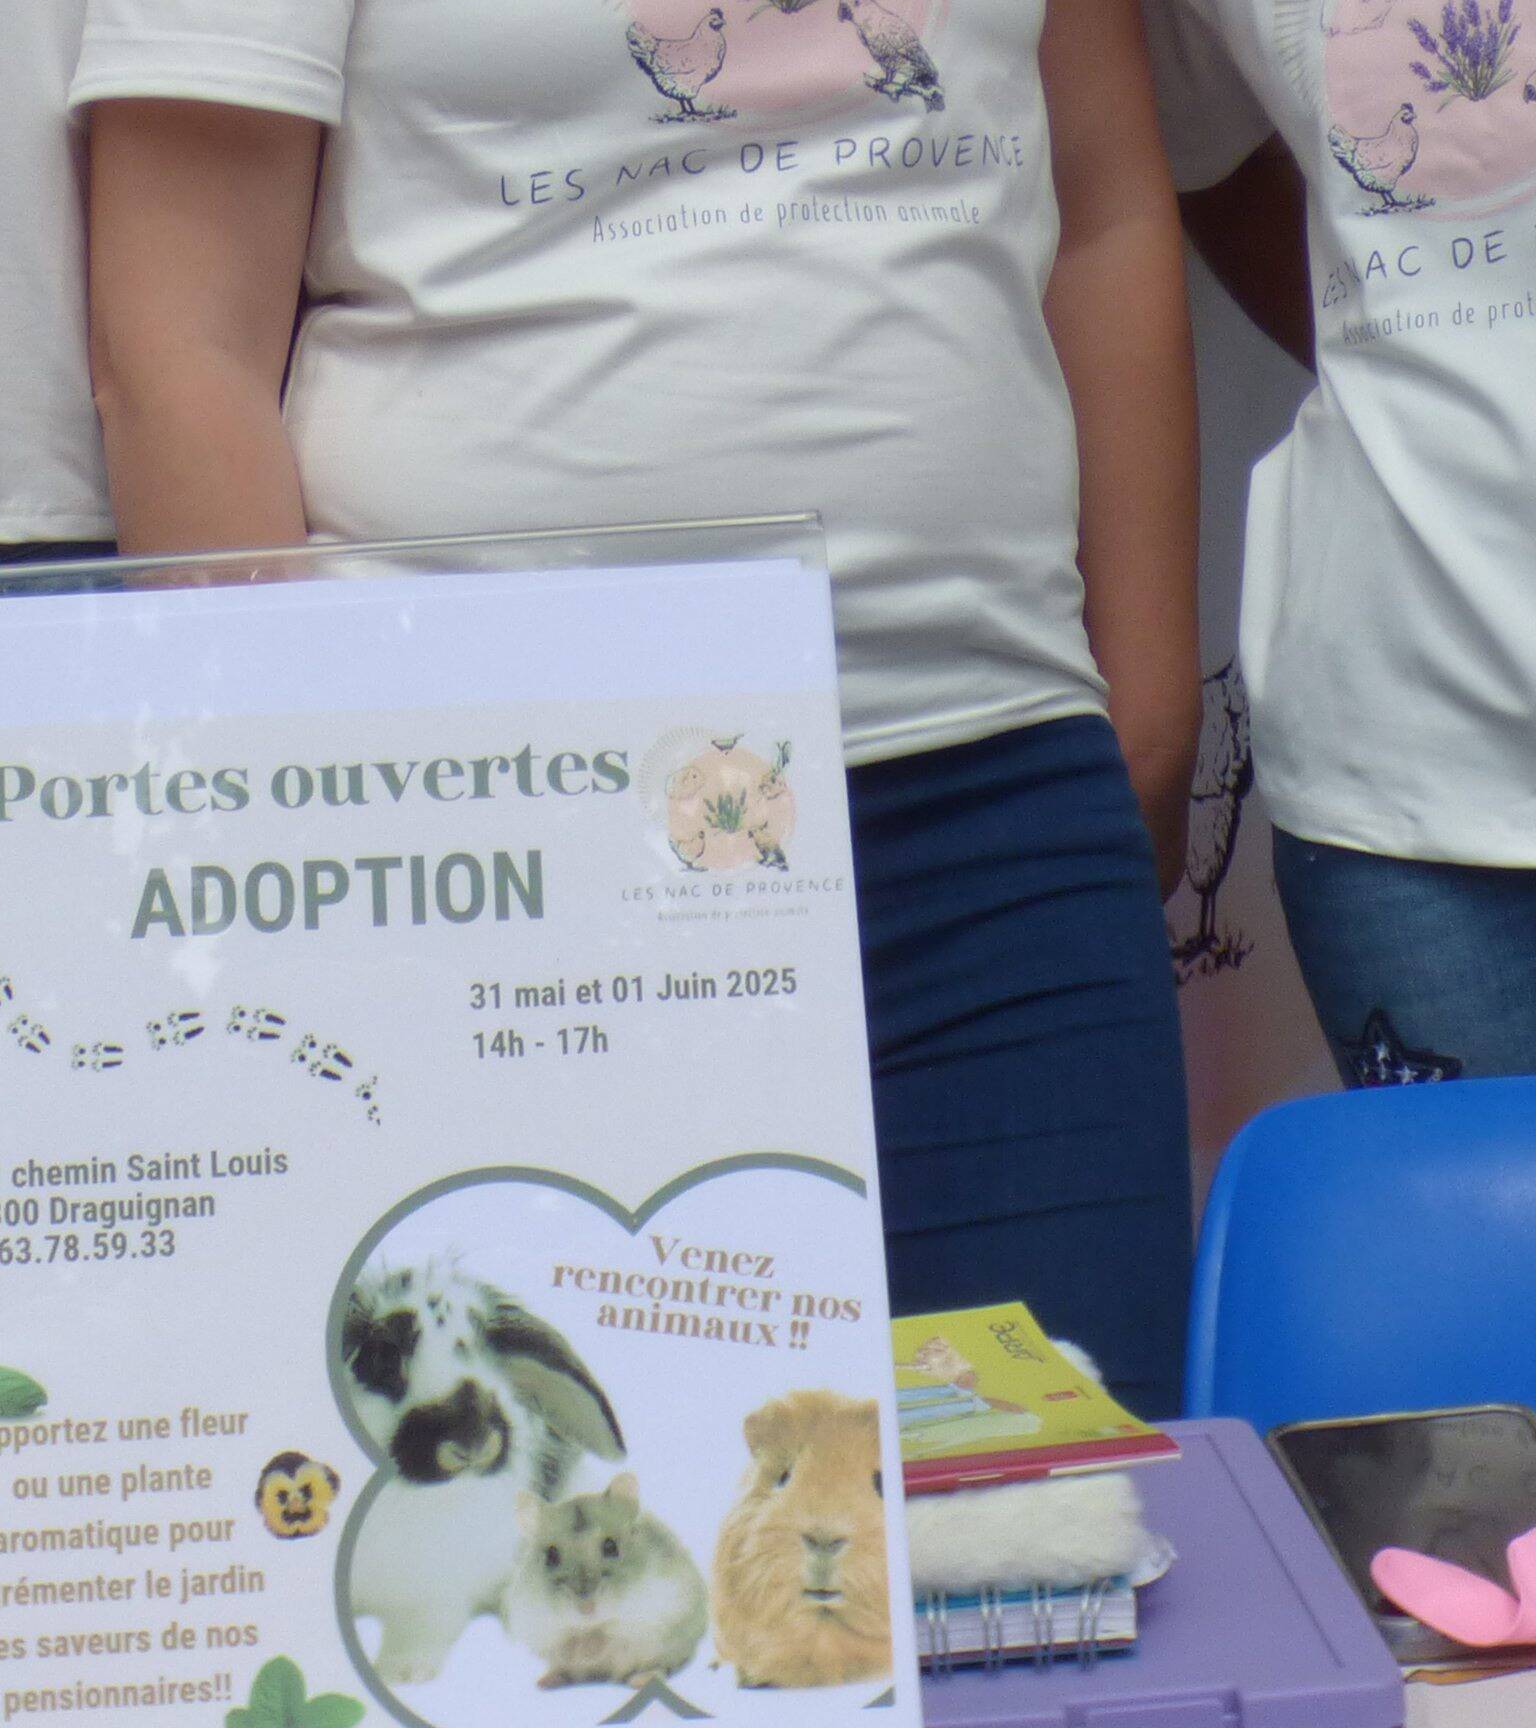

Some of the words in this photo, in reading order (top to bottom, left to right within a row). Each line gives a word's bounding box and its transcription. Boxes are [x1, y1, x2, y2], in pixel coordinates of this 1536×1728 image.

[501, 169, 586, 207] LES
[615, 147, 708, 186] NAC
[741, 140, 799, 172] DE
[835, 134, 1024, 170] PROVENCE
[592, 208, 728, 244] Association
[740, 199, 764, 223] de
[777, 196, 889, 228] protection
[897, 196, 981, 226] animale
[1452, 229, 1507, 269] DE
[1452, 300, 1476, 326] de
[270, 742, 631, 809] ouvertes
[130, 849, 545, 940] ADOPTION
[621, 886, 655, 902] LES
[665, 884, 703, 899] NAC
[712, 883, 735, 898] DE
[746, 877, 845, 896] PROVENCE
[469, 982, 502, 1011] 31
[514, 978, 566, 1009] mai
[575, 977, 603, 1005] et
[612, 975, 644, 1004] 01
[656, 971, 718, 1002] Juin
[725, 967, 798, 999] 2025
[472, 1028, 525, 1060] 14h
[534, 1039, 546, 1050] -
[556, 1024, 609, 1056] 17h
[11, 1155, 116, 1189] chemin
[126, 1152, 202, 1183] Saint
[210, 1146, 289, 1179] Louis
[48, 1191, 216, 1229] Draguignan
[649, 1233, 776, 1280] Venez
[550, 1263, 783, 1315] rencontrer
[790, 1291, 862, 1323] nos
[596, 1301, 781, 1349] animaux
[117, 1415, 171, 1442] une
[180, 1405, 249, 1439] fleur
[13, 1474, 49, 1500] ou
[58, 1471, 112, 1497] une
[120, 1462, 213, 1502] plante
[168, 1517, 237, 1553] pour
[144, 1568, 172, 1600] le
[178, 1563, 265, 1606] jardin
[36, 1627, 152, 1659] saveurs
[160, 1620, 197, 1651] de
[205, 1621, 260, 1650] nos
[3, 1671, 233, 1723] pensionnaires!!
